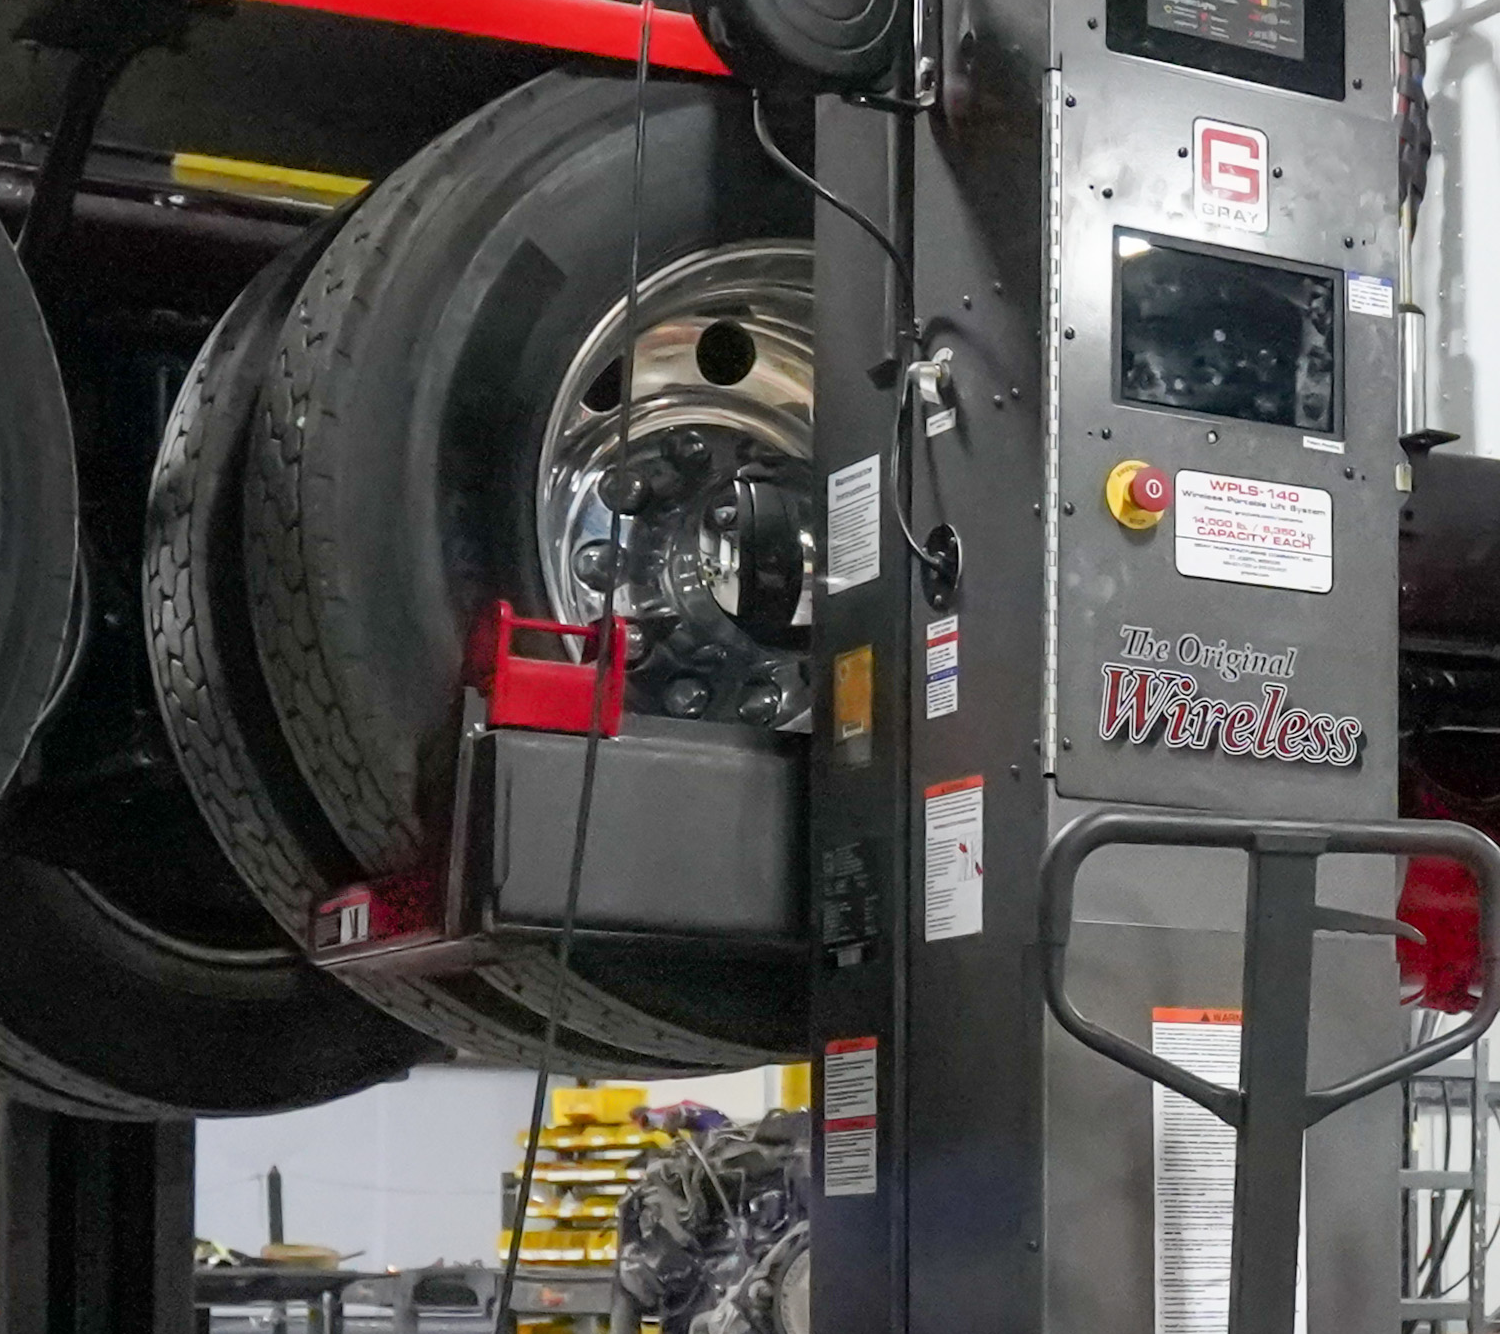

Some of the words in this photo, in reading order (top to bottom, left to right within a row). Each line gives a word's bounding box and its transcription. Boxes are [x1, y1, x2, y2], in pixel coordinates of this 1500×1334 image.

[1202, 202, 1259, 224] GRAY
[1210, 479, 1300, 503] WPLS-140
[1182, 489, 1223, 502] Wireless
[1227, 495, 1267, 509] Portable
[1270, 503, 1287, 512] Lift
[1290, 505, 1326, 517] System
[1193, 516, 1233, 528] 14,000
[1197, 526, 1268, 543] CAPACITY
[1273, 536, 1312, 549] EACH
[1120, 624, 1171, 662] The
[1176, 633, 1298, 683] Original
[1100, 662, 1362, 766] Wireless
[1213, 1013, 1242, 1022] WARN
